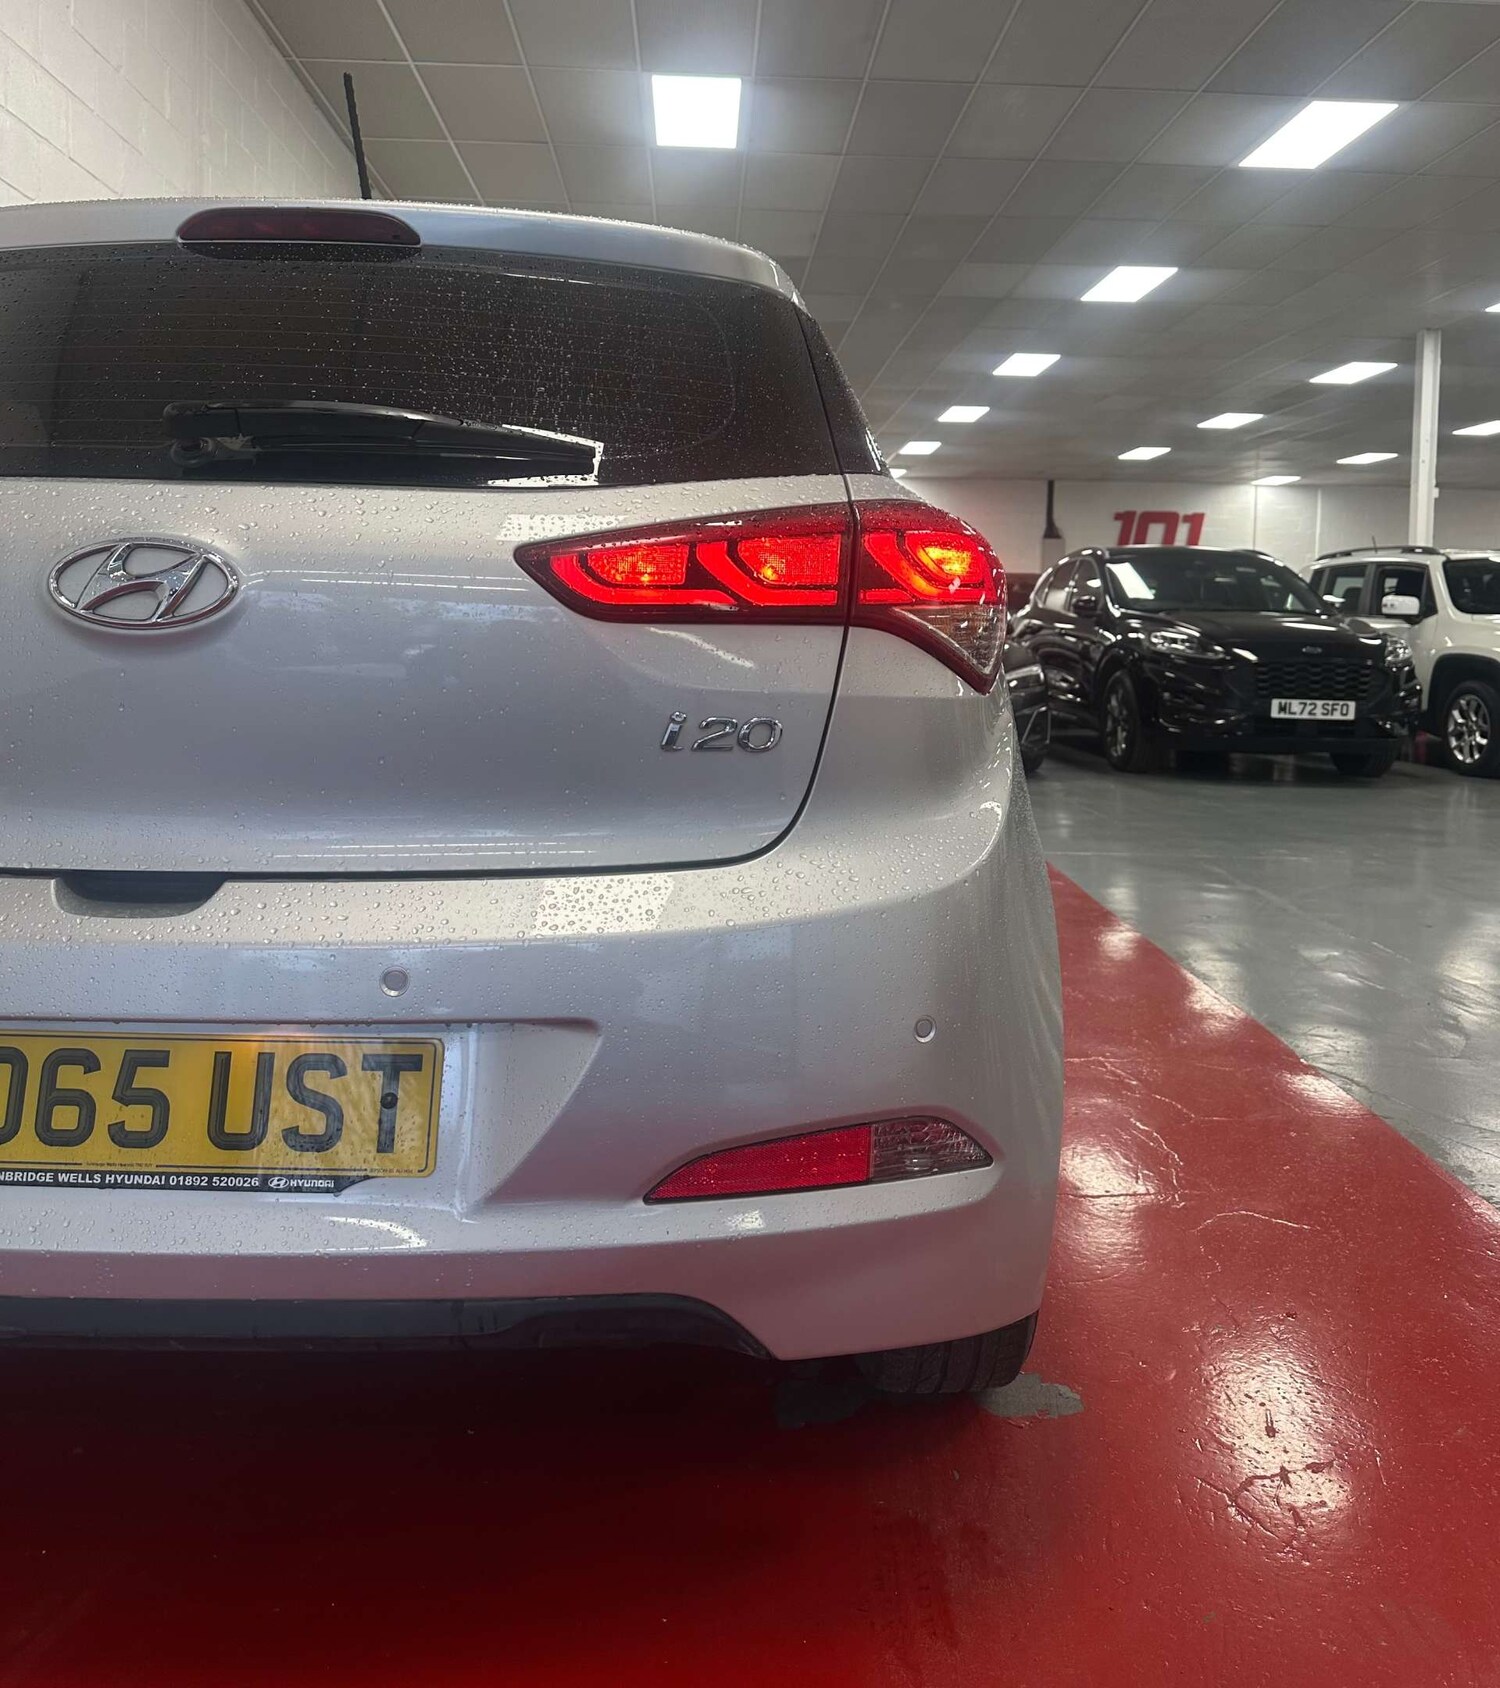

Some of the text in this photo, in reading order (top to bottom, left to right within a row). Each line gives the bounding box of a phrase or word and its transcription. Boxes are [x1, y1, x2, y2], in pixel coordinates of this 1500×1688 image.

[1113, 511, 1205, 546] 101
[1277, 701, 1318, 717] ML72
[660, 711, 783, 752] i20
[207, 1051, 424, 1154] UST
[58, 1172, 101, 1184] WELLS
[105, 1174, 165, 1186] HYUNDAI
[169, 1175, 209, 1187] 01892
[212, 1177, 259, 1187] 520026
[290, 1179, 334, 1188] HYUNDAI
